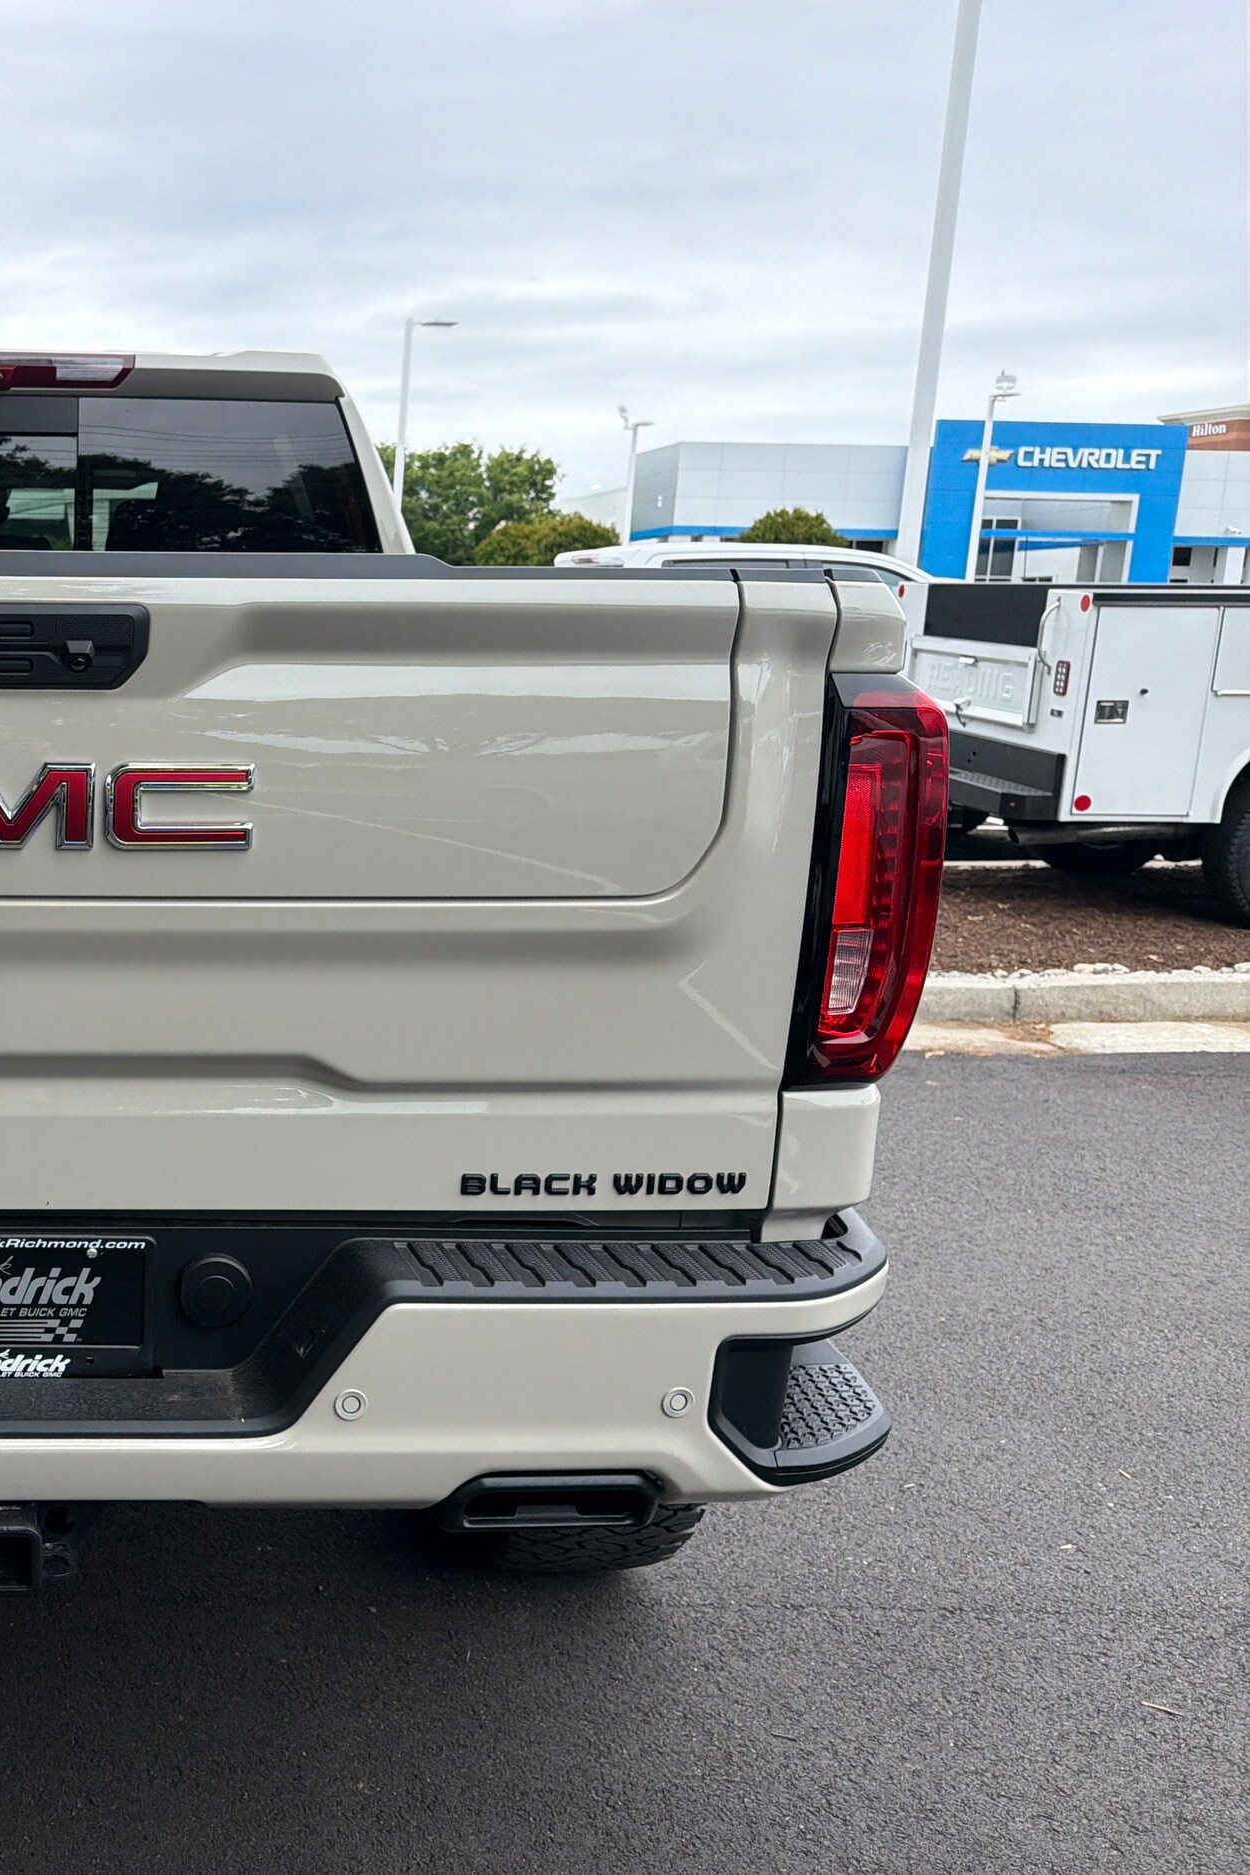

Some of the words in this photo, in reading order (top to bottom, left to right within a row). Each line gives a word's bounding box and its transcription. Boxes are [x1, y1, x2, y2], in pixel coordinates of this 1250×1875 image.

[1192, 422, 1227, 437] Hilton
[1017, 446, 1163, 470] CHEVROLET
[460, 1173, 598, 1196] BLACK
[613, 1172, 748, 1195] WIDOW
[19, 1307, 55, 1317] BUICK
[59, 1307, 88, 1317] GMC
